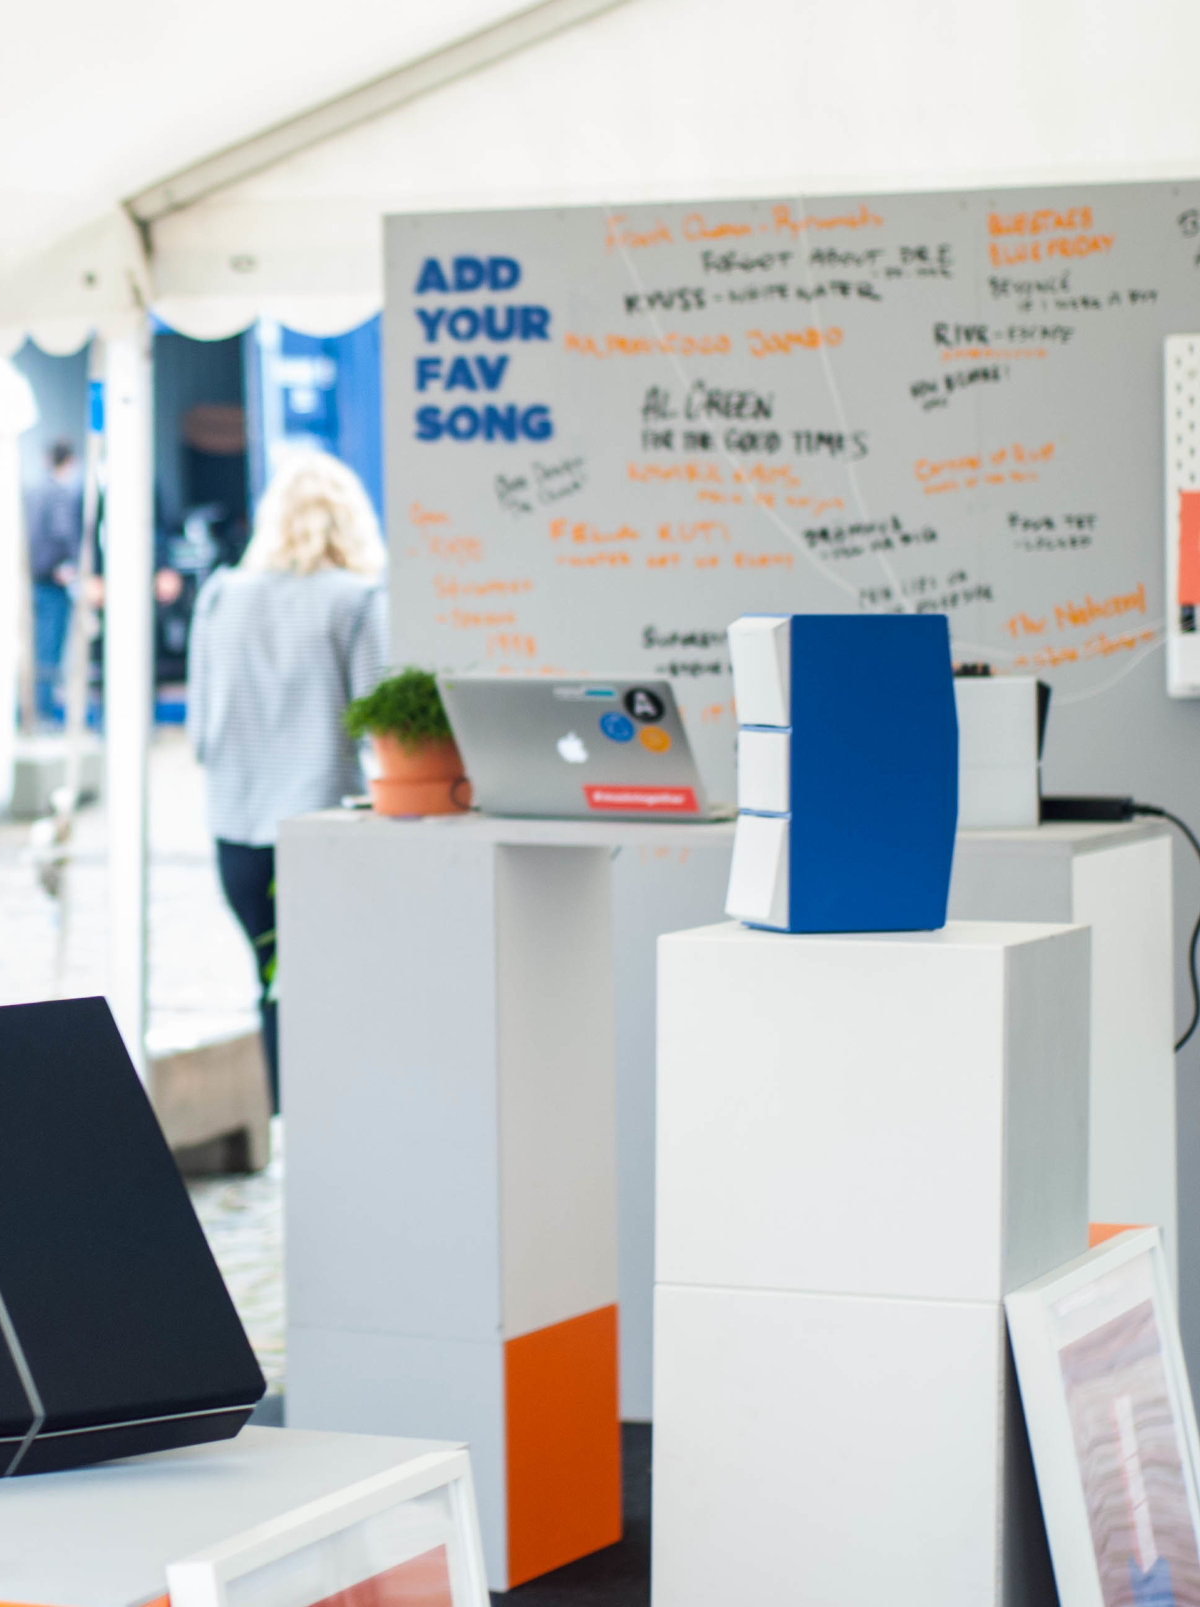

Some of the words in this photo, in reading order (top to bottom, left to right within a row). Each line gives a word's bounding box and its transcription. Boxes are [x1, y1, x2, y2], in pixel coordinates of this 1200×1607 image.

[415, 255, 521, 295] ADD
[416, 305, 551, 343] YOUR
[416, 355, 509, 392] FAV
[415, 404, 554, 443] SONG
[633, 691, 655, 716] A
